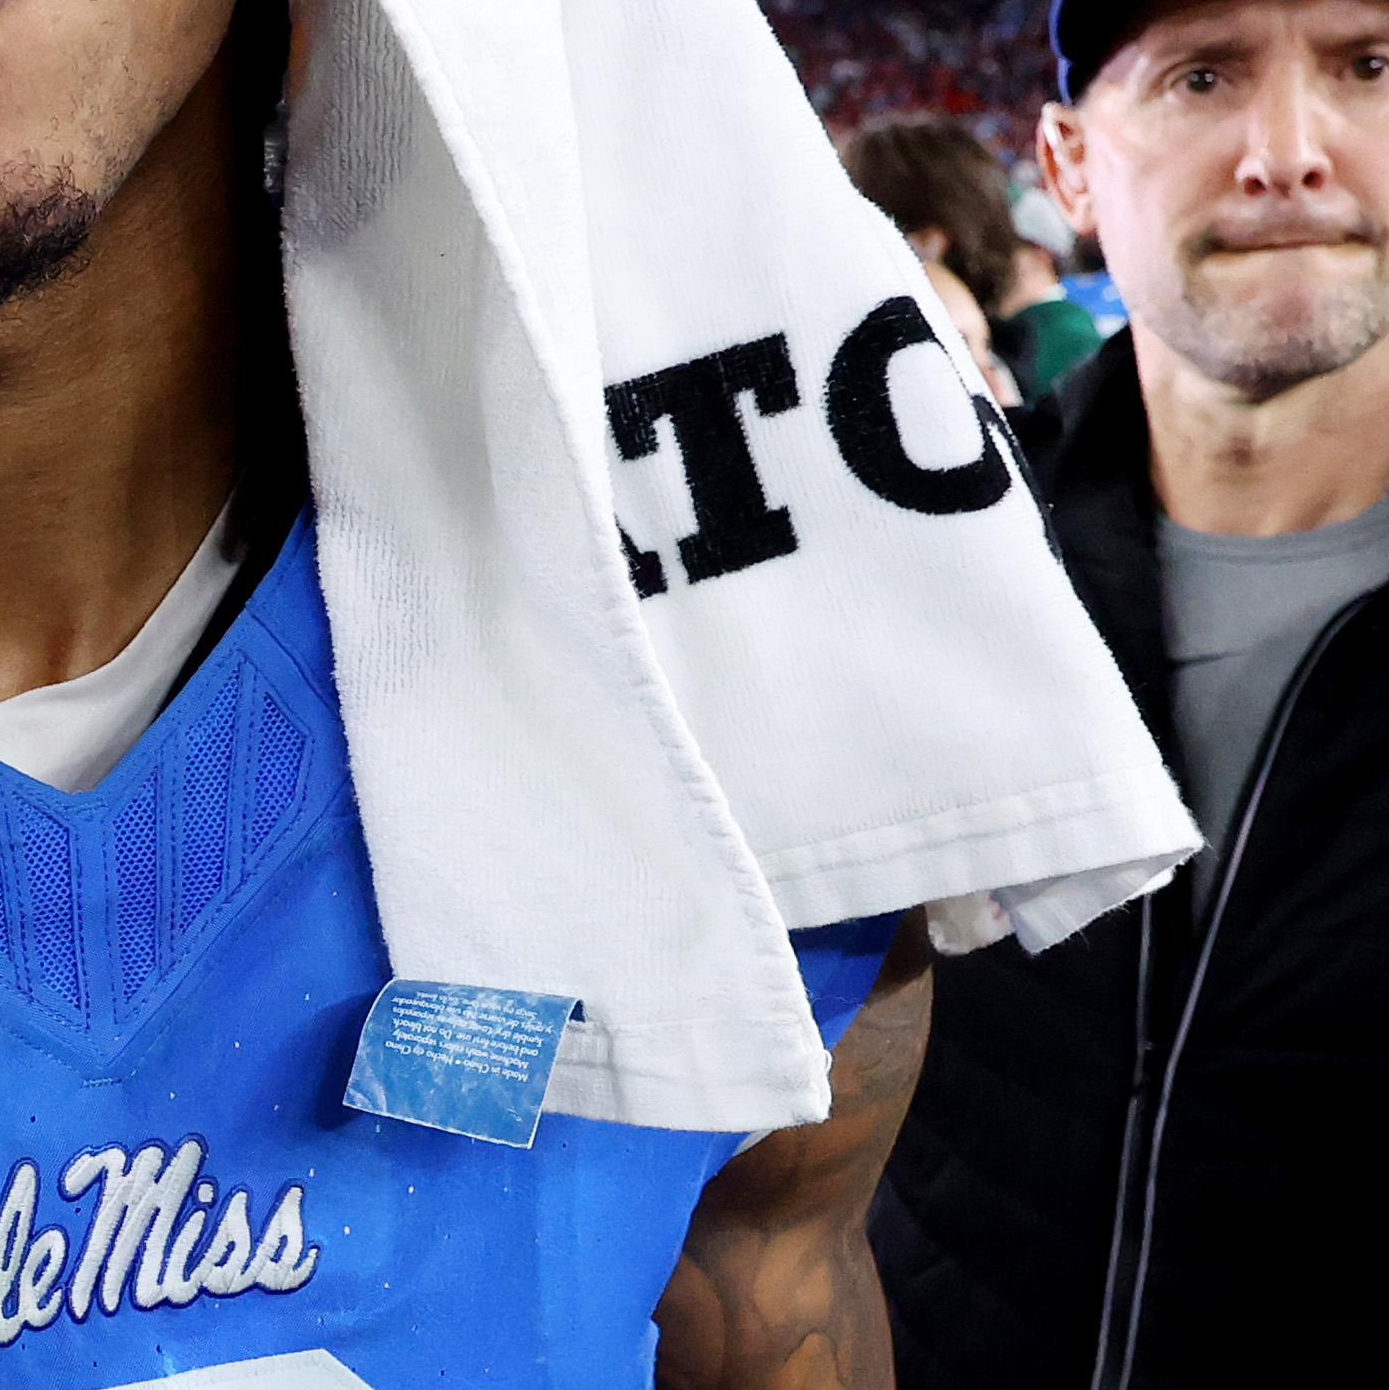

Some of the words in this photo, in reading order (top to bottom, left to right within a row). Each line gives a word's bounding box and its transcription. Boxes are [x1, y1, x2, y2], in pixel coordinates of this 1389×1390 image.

[392, 1025, 436, 1045] separately
[384, 1040, 411, 1054] China
[438, 1041, 464, 1053] colors
[465, 1047, 488, 1057] wash
[519, 1046, 538, 1057] and
[425, 1050, 453, 1065] Hecho
[501, 1068, 528, 1082] Made
[62, 1137, 321, 1321] Miss
